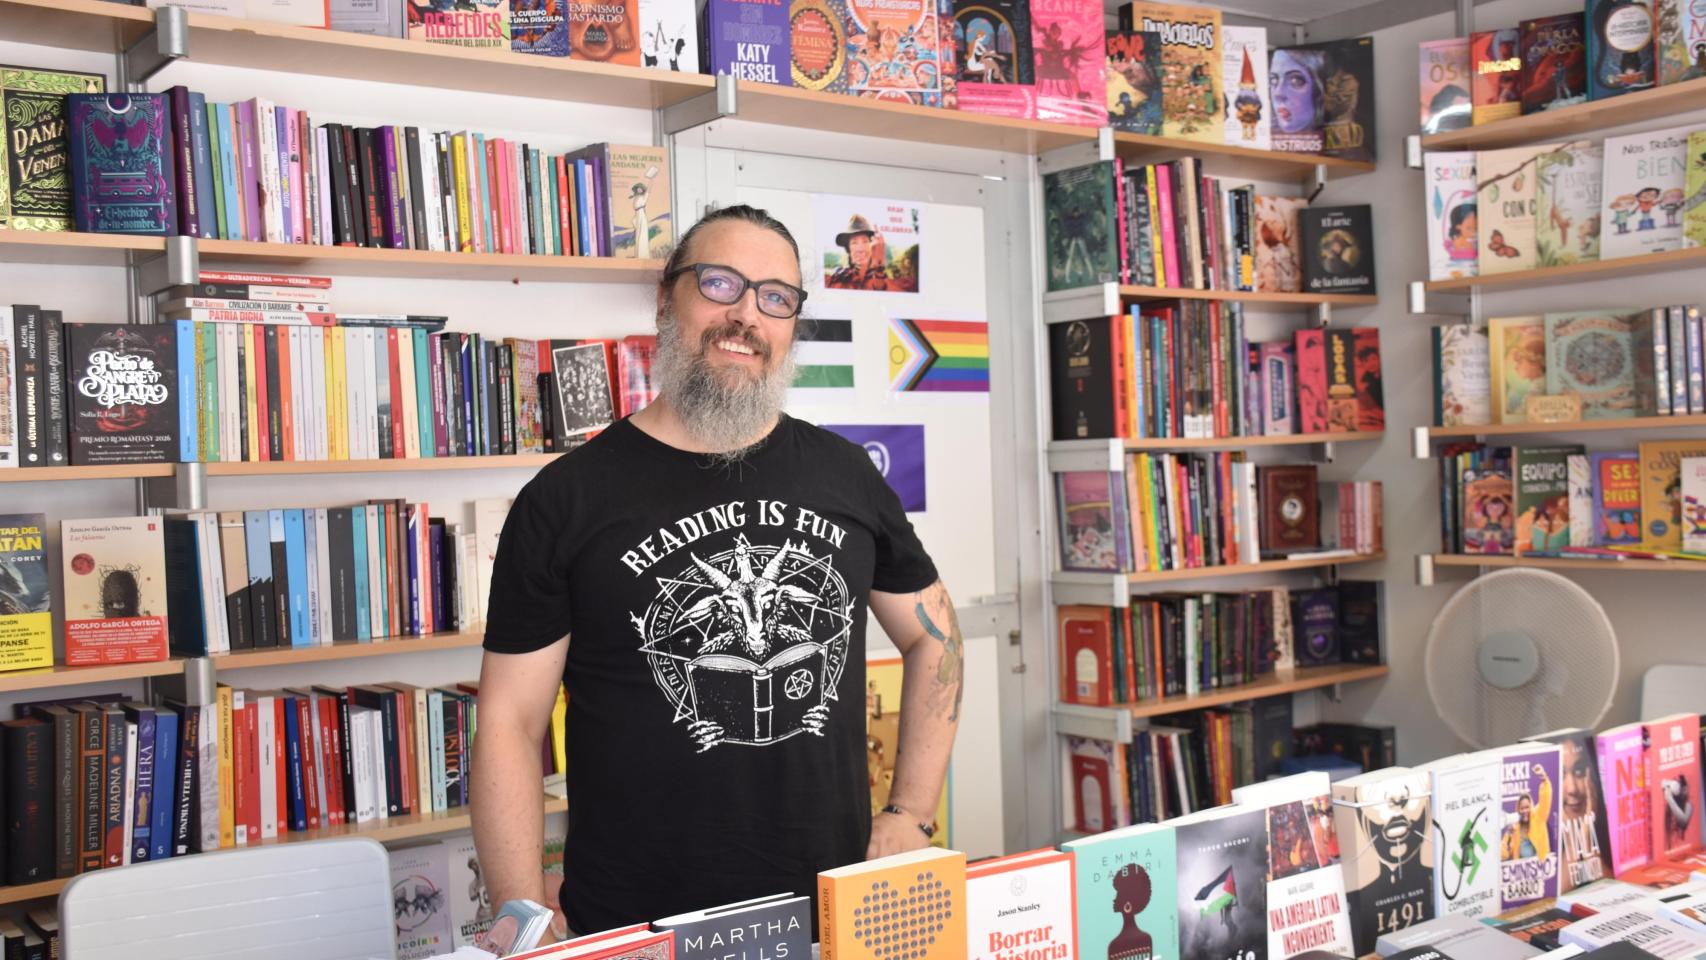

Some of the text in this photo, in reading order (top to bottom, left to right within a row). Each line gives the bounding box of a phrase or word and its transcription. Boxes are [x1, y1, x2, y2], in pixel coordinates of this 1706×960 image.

[425, 11, 503, 38] REBELDES
[514, 16, 565, 24] UNA DISCULPA
[737, 42, 770, 63] KATY
[730, 62, 779, 84] HESSEL
[629, 154, 664, 163] MUJERES
[1636, 156, 1687, 180] BIEN
[1503, 201, 1526, 218] CON
[208, 310, 265, 322] PATRIA DIGNA
[89, 350, 155, 372] Pacto de
[26, 376, 35, 415] ESPERANZA
[98, 384, 168, 409] PLATA
[27, 416, 36, 441] ÚLTIMA
[80, 435, 110, 443] PREMIO
[112, 435, 154, 443] ROMANTASY
[1521, 462, 1566, 481] EQUIPO
[20, 526, 40, 534] DEL
[620, 499, 849, 578] READING IS FUN
[70, 619, 161, 630] ADOLFO GARCÍA ORTEGA
[64, 727, 73, 759] CANCIÓN
[138, 746, 152, 788] HERA
[89, 718, 99, 849] CIRCE MADELINE MILLER
[110, 765, 121, 822] ARIADNA
[181, 768, 192, 802] HUELLA
[1445, 802, 1460, 811] PIEL
[179, 803, 189, 839] VIKINGA
[1223, 837, 1250, 848] BACONI
[1102, 847, 1152, 867] EMMA
[1093, 859, 1161, 883] DABIRI
[1507, 879, 1541, 898] BARRIO
[997, 902, 1041, 918] Jason Stanley
[1269, 893, 1341, 932] UNA AMÉRICA LATINA
[1375, 895, 1401, 907] CHARLES
[1448, 889, 1494, 913] COMBUSTIBLE
[1377, 901, 1425, 933] 1491
[685, 915, 800, 953] MARTHA
[989, 925, 1053, 953] Borrar
[1282, 920, 1336, 956] INCONVENIENTE
